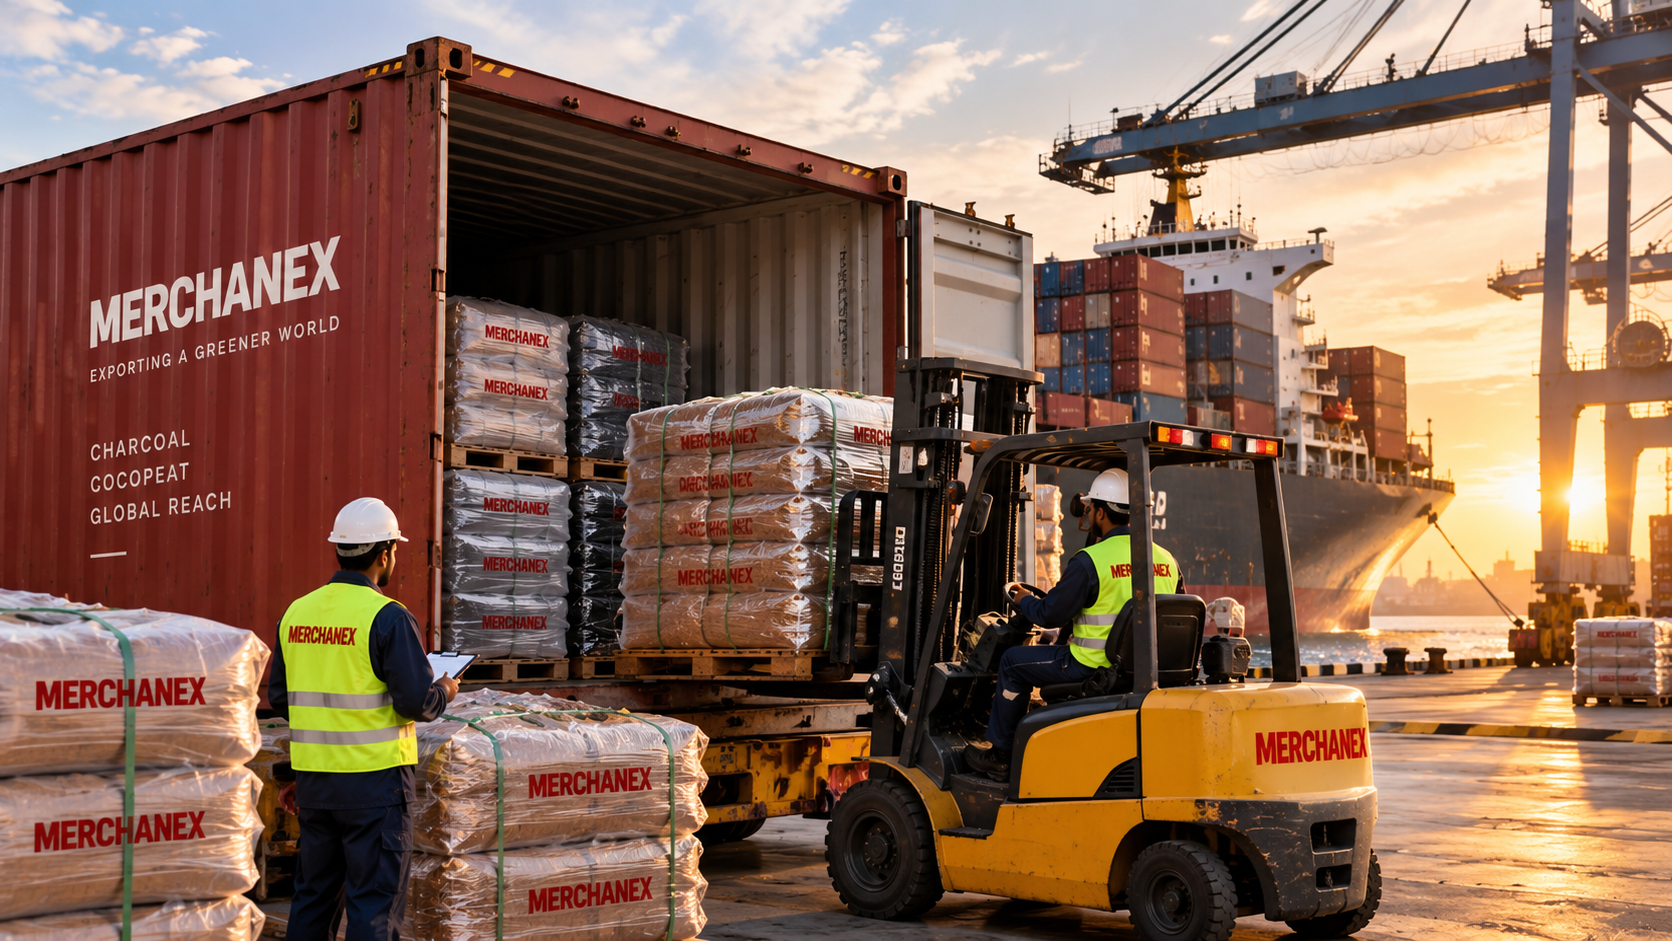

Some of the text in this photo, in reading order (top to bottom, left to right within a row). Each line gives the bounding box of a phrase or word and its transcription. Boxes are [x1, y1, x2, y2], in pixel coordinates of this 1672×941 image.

[90, 235, 341, 348] MERCHANEX
[90, 315, 340, 383] EXPORTING A GREENER WORLD
[485, 324, 549, 348] MERCHANEX
[484, 378, 549, 400] MERCHANEX
[90, 430, 190, 461] CHARCOAL
[854, 425, 891, 447] MERCH
[90, 462, 189, 493] COCOPEAT
[90, 491, 231, 525] GLOBAL REACH
[484, 497, 549, 516] MERCHANEX
[483, 557, 548, 573] MERCHANEX
[677, 567, 753, 586] MERCHANEX
[1110, 563, 1171, 579] MERNEX
[288, 625, 357, 646] MERCHANEX
[482, 615, 547, 630] MERCHANEX
[36, 676, 206, 711] MERCHANEX
[1255, 727, 1368, 766] MERCHANEX
[528, 767, 652, 799] MERCHANEX
[34, 811, 206, 853] MERCHANEX
[528, 876, 653, 914] MERCHANEX
